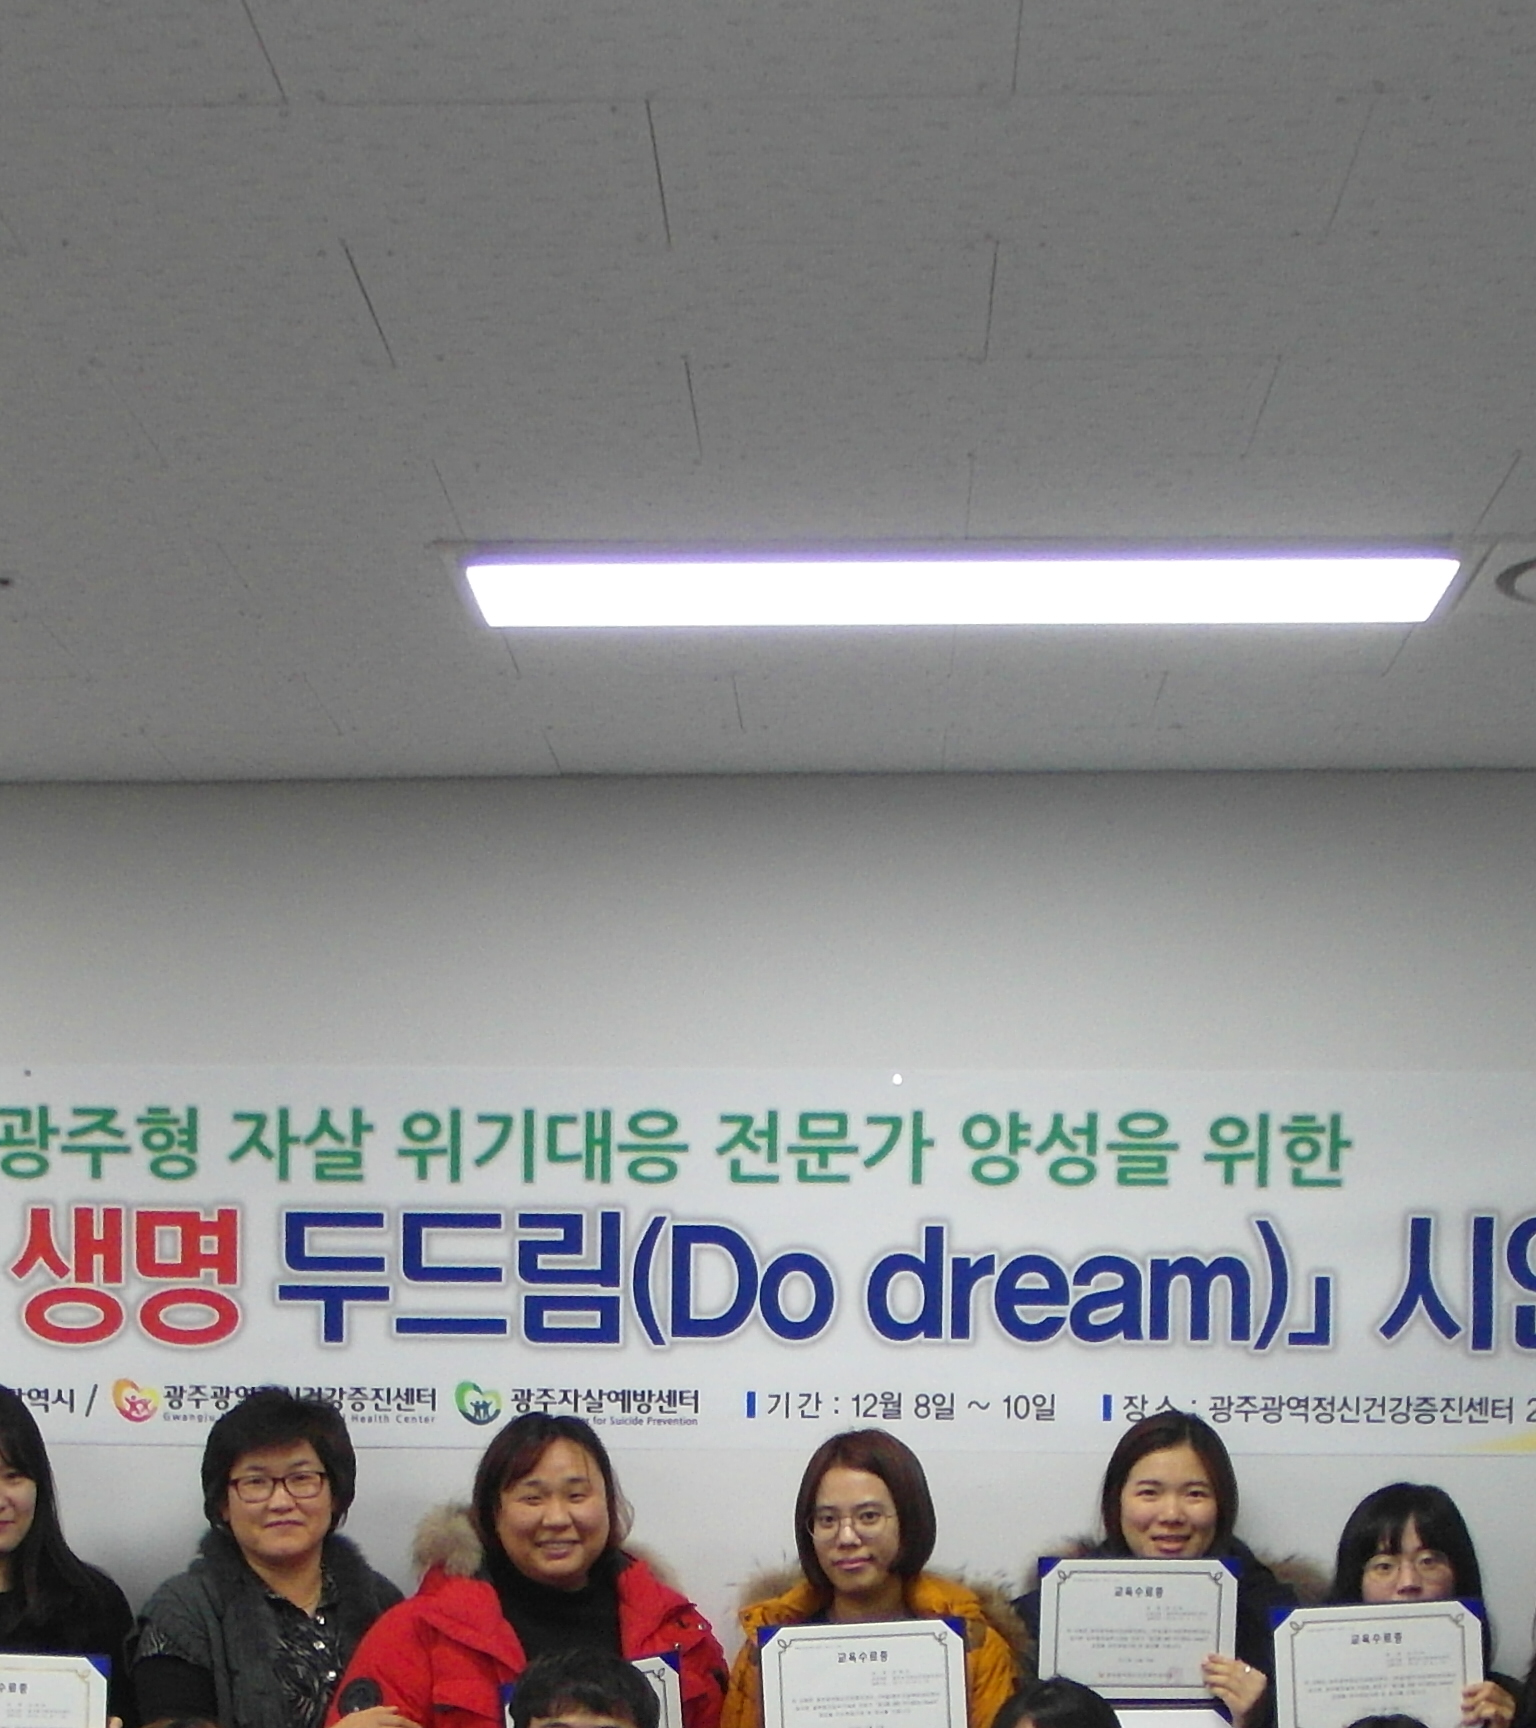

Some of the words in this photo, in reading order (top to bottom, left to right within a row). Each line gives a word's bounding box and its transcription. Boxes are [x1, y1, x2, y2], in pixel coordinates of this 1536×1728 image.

[230, 1108, 371, 1181] 자살
[399, 1109, 688, 1183] 위기대응
[717, 1111, 932, 1183] 전문가
[962, 1112, 1177, 1186] 양성을
[1206, 1113, 1351, 1187] 위한
[13, 1208, 238, 1344] 생명
[279, 1212, 834, 1345] 두드림(Do
[867, 1220, 1330, 1350] dream)」
[511, 1388, 699, 1414] 광주자살예방센터
[851, 1391, 902, 1420] 12월
[914, 1392, 955, 1421] 8일
[1002, 1393, 1056, 1422] 10일
[1208, 1395, 1514, 1424] 광주광역정신건강증진센터
[351, 1414, 389, 1423] Health
[396, 1414, 436, 1423] Center
[593, 1415, 607, 1425] for
[610, 1416, 643, 1426] Suicide
[647, 1416, 698, 1427] Prevention
